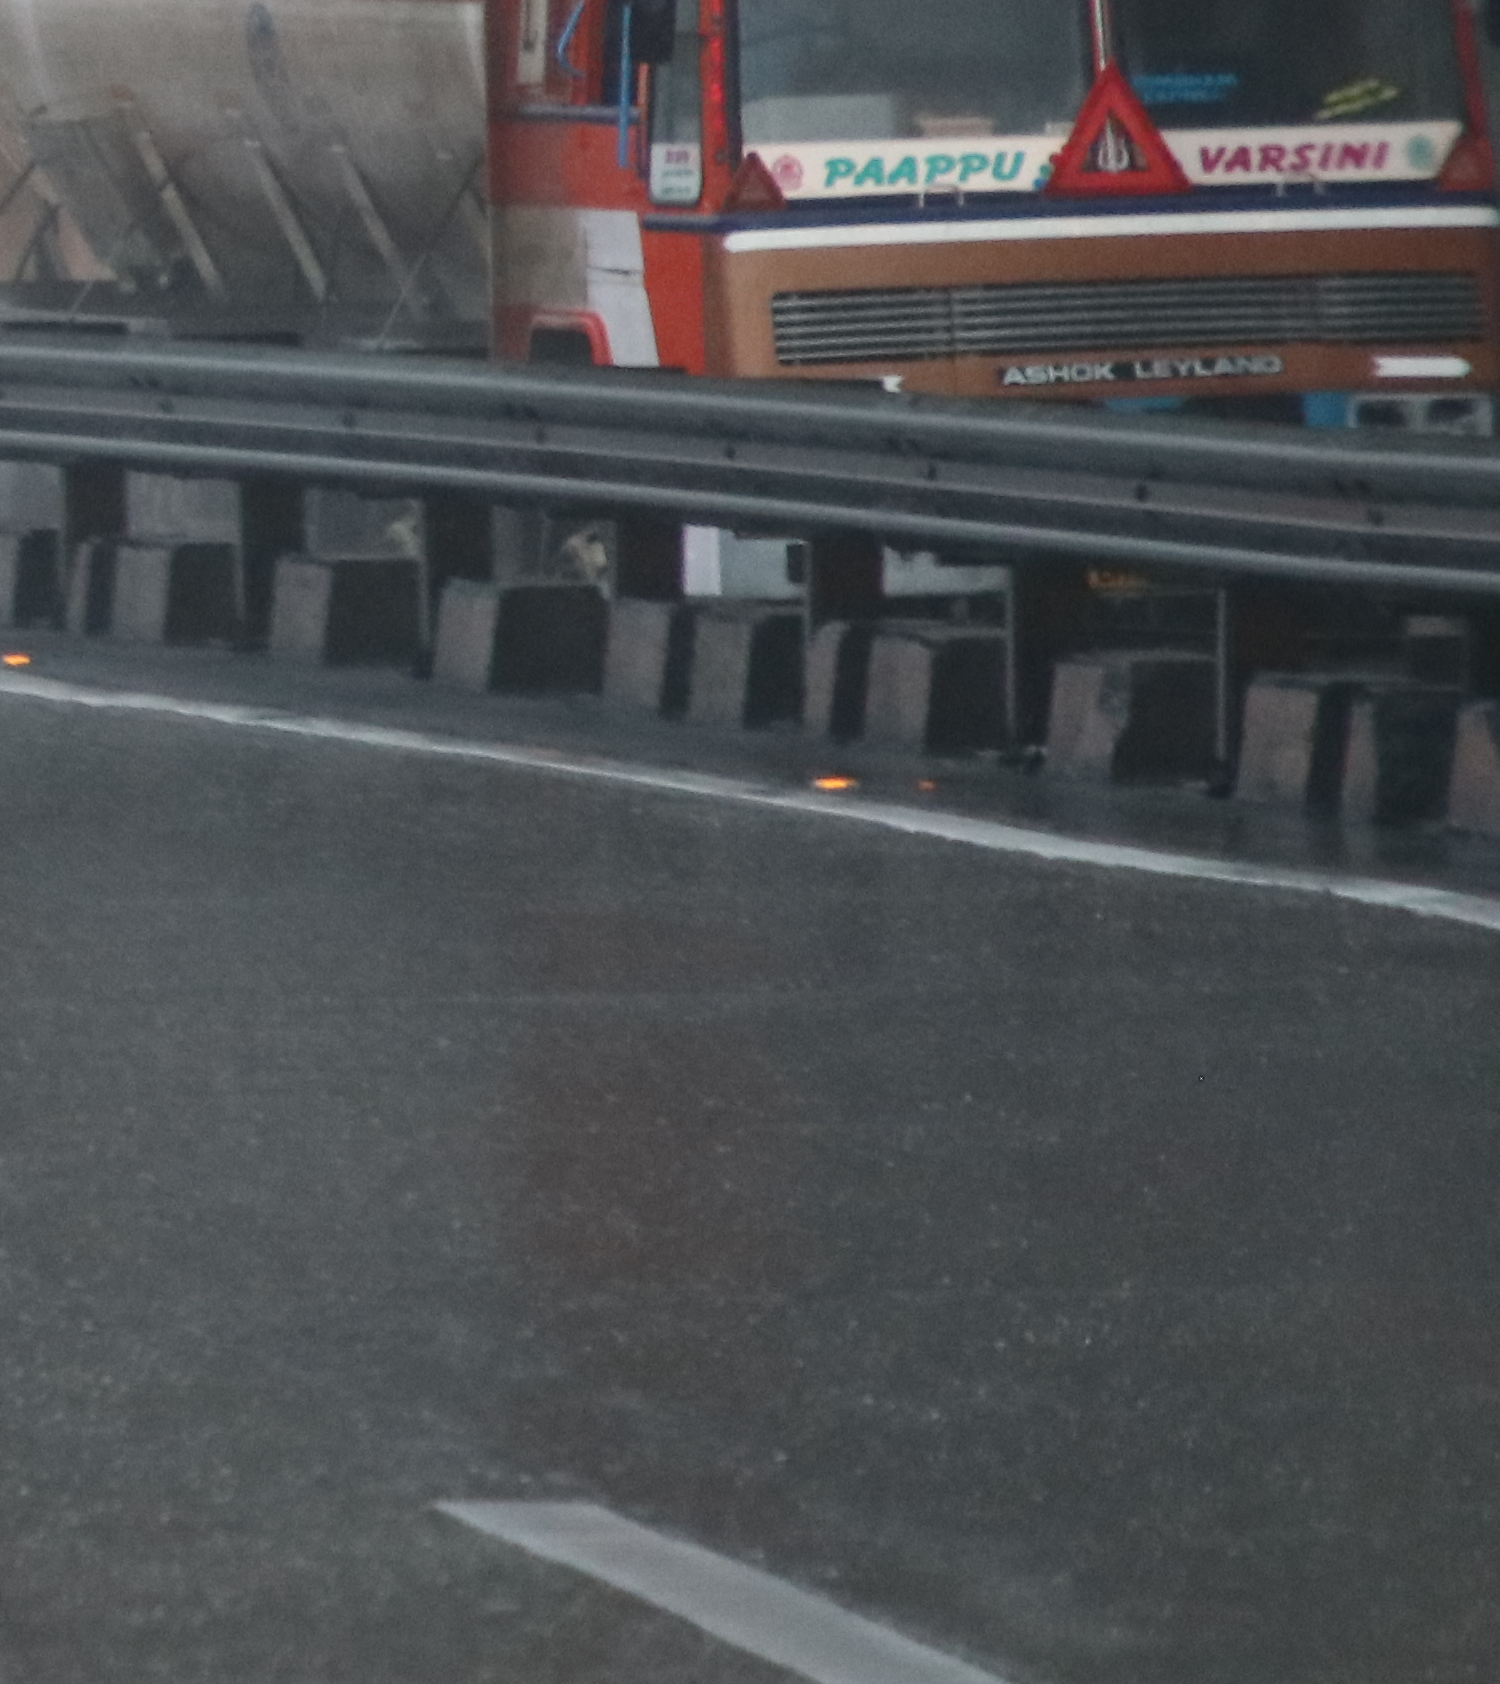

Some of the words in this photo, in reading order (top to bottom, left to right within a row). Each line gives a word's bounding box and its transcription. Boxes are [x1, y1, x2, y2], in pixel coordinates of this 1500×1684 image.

[823, 151, 1026, 188] PAAPPU
[1199, 141, 1391, 174] VARSINI
[1003, 361, 1116, 387] ASHOK
[1133, 354, 1284, 379] LEYLAND
